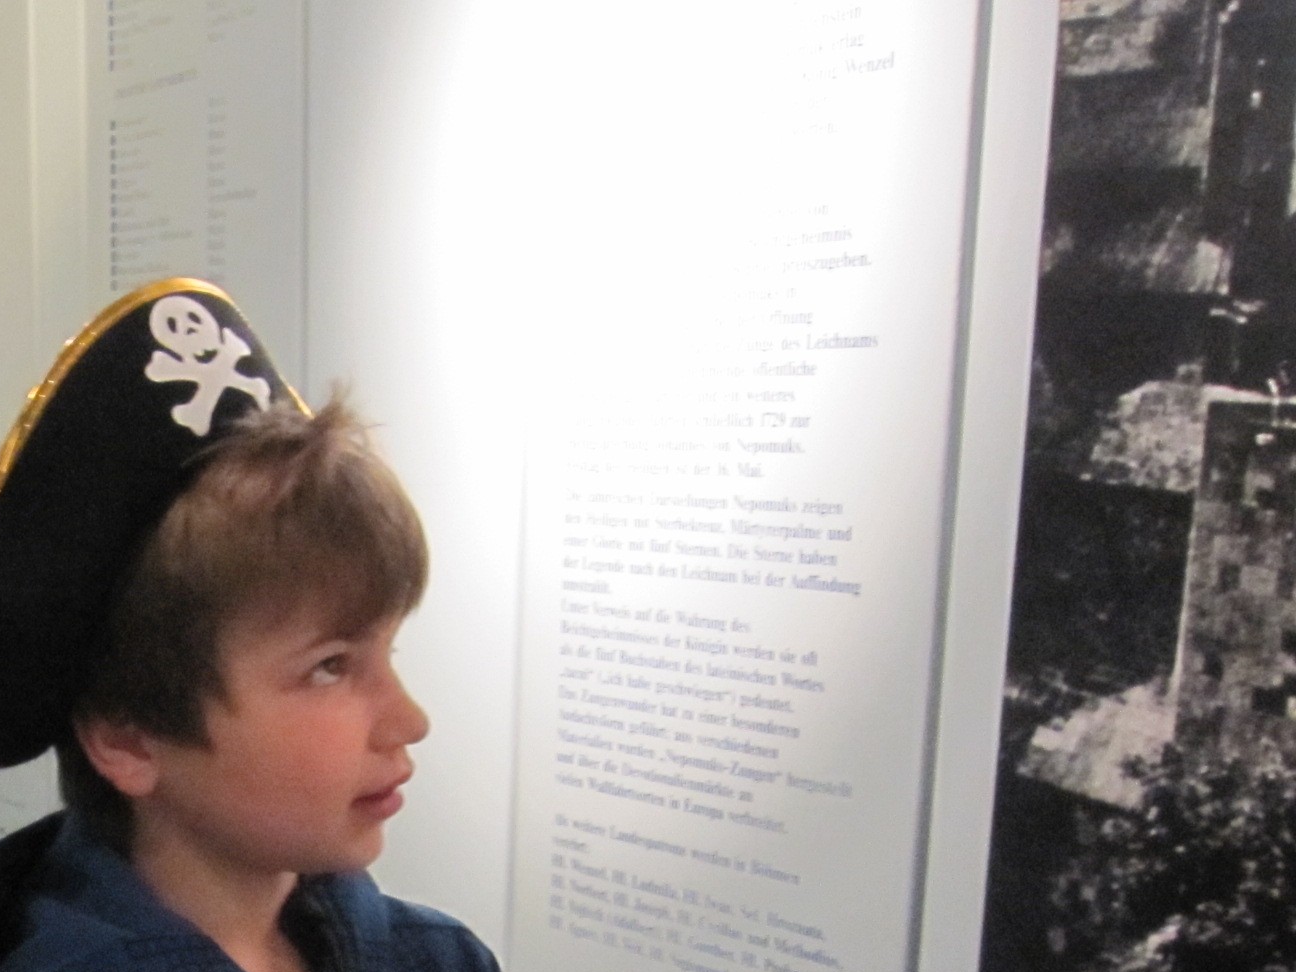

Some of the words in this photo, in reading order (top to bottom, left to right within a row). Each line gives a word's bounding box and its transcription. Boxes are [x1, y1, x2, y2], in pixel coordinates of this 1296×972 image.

[844, 51, 896, 73] Wenzel
[806, 332, 880, 351] Leichnams
[732, 494, 798, 515] Nepomuks
[801, 497, 844, 516] zeigen
[827, 525, 853, 542] und
[753, 544, 793, 563] Sterne
[798, 548, 837, 567] haben
